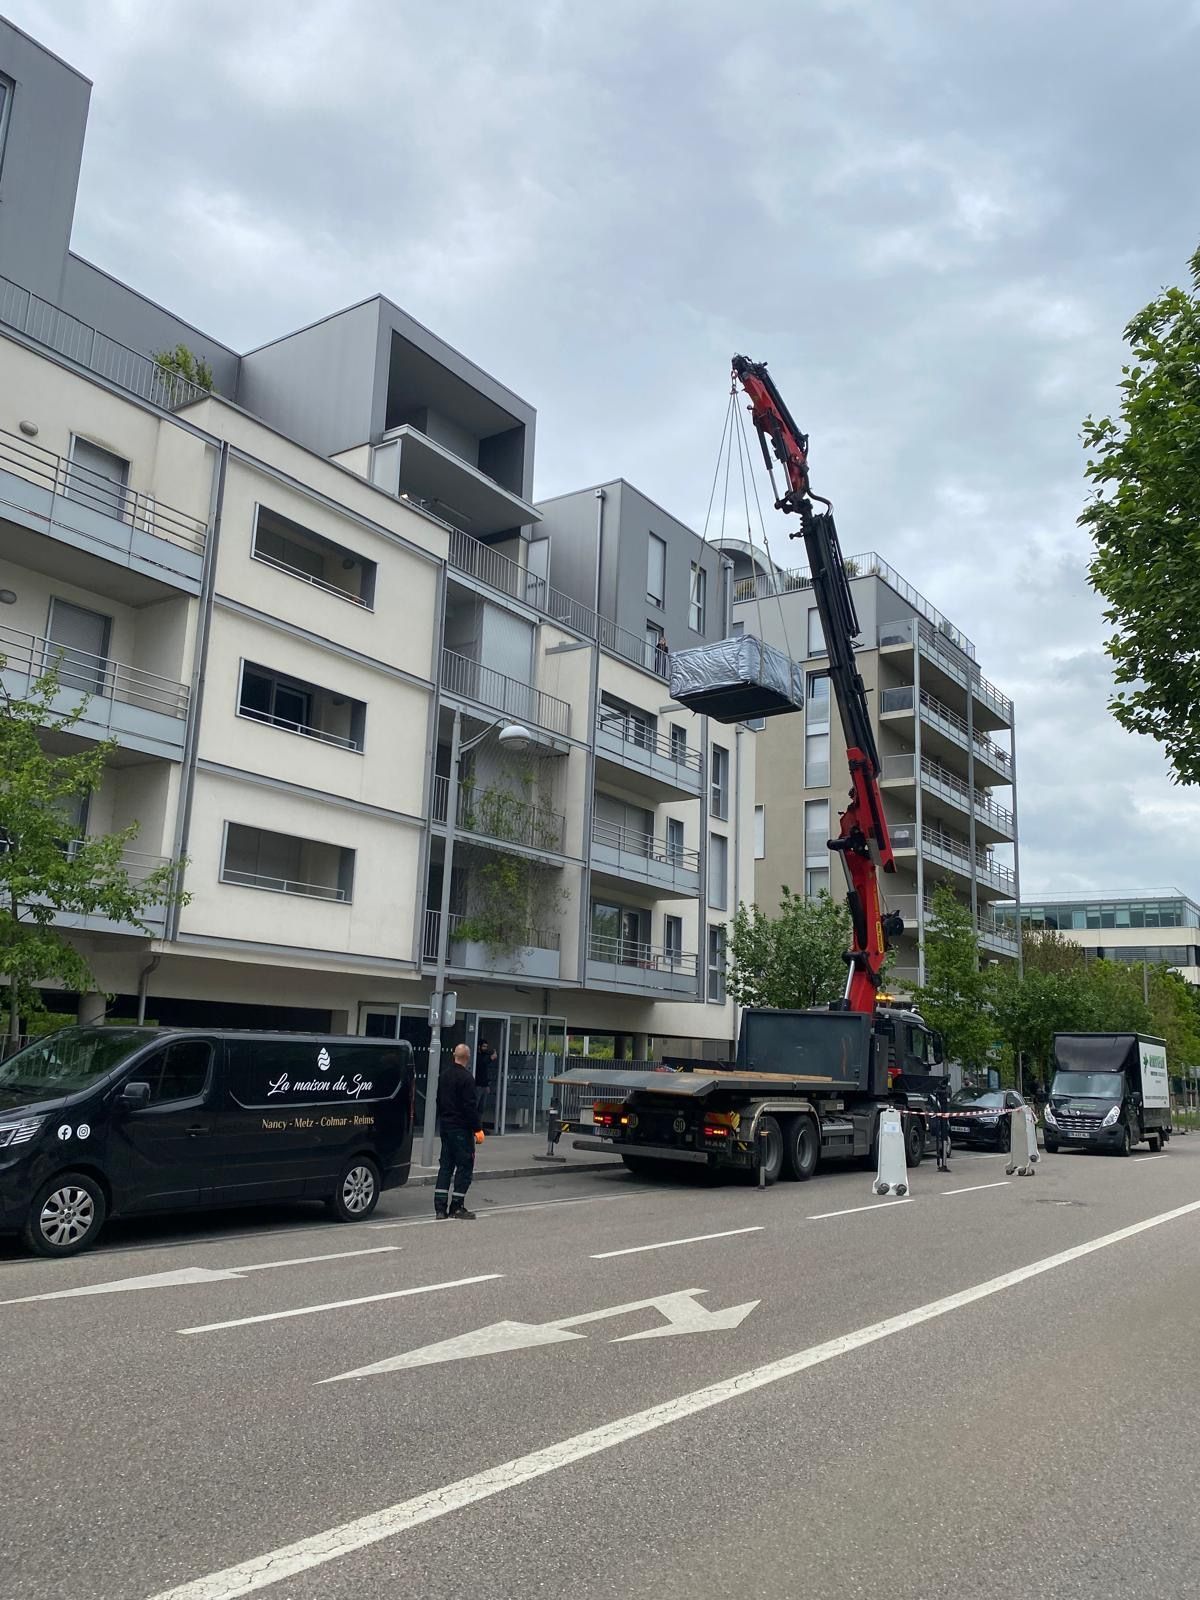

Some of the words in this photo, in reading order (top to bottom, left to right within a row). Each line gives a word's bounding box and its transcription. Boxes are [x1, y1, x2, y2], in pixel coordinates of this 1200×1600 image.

[267, 1072, 290, 1096] La
[293, 1079, 330, 1091] maison
[332, 1075, 347, 1091] du
[346, 1073, 373, 1099] Spa
[262, 1118, 287, 1130] Nancy
[294, 1117, 314, 1128] Metz
[320, 1116, 347, 1127] Colmar
[353, 1115, 374, 1125] Reims
[674, 1121, 684, 1132] 90
